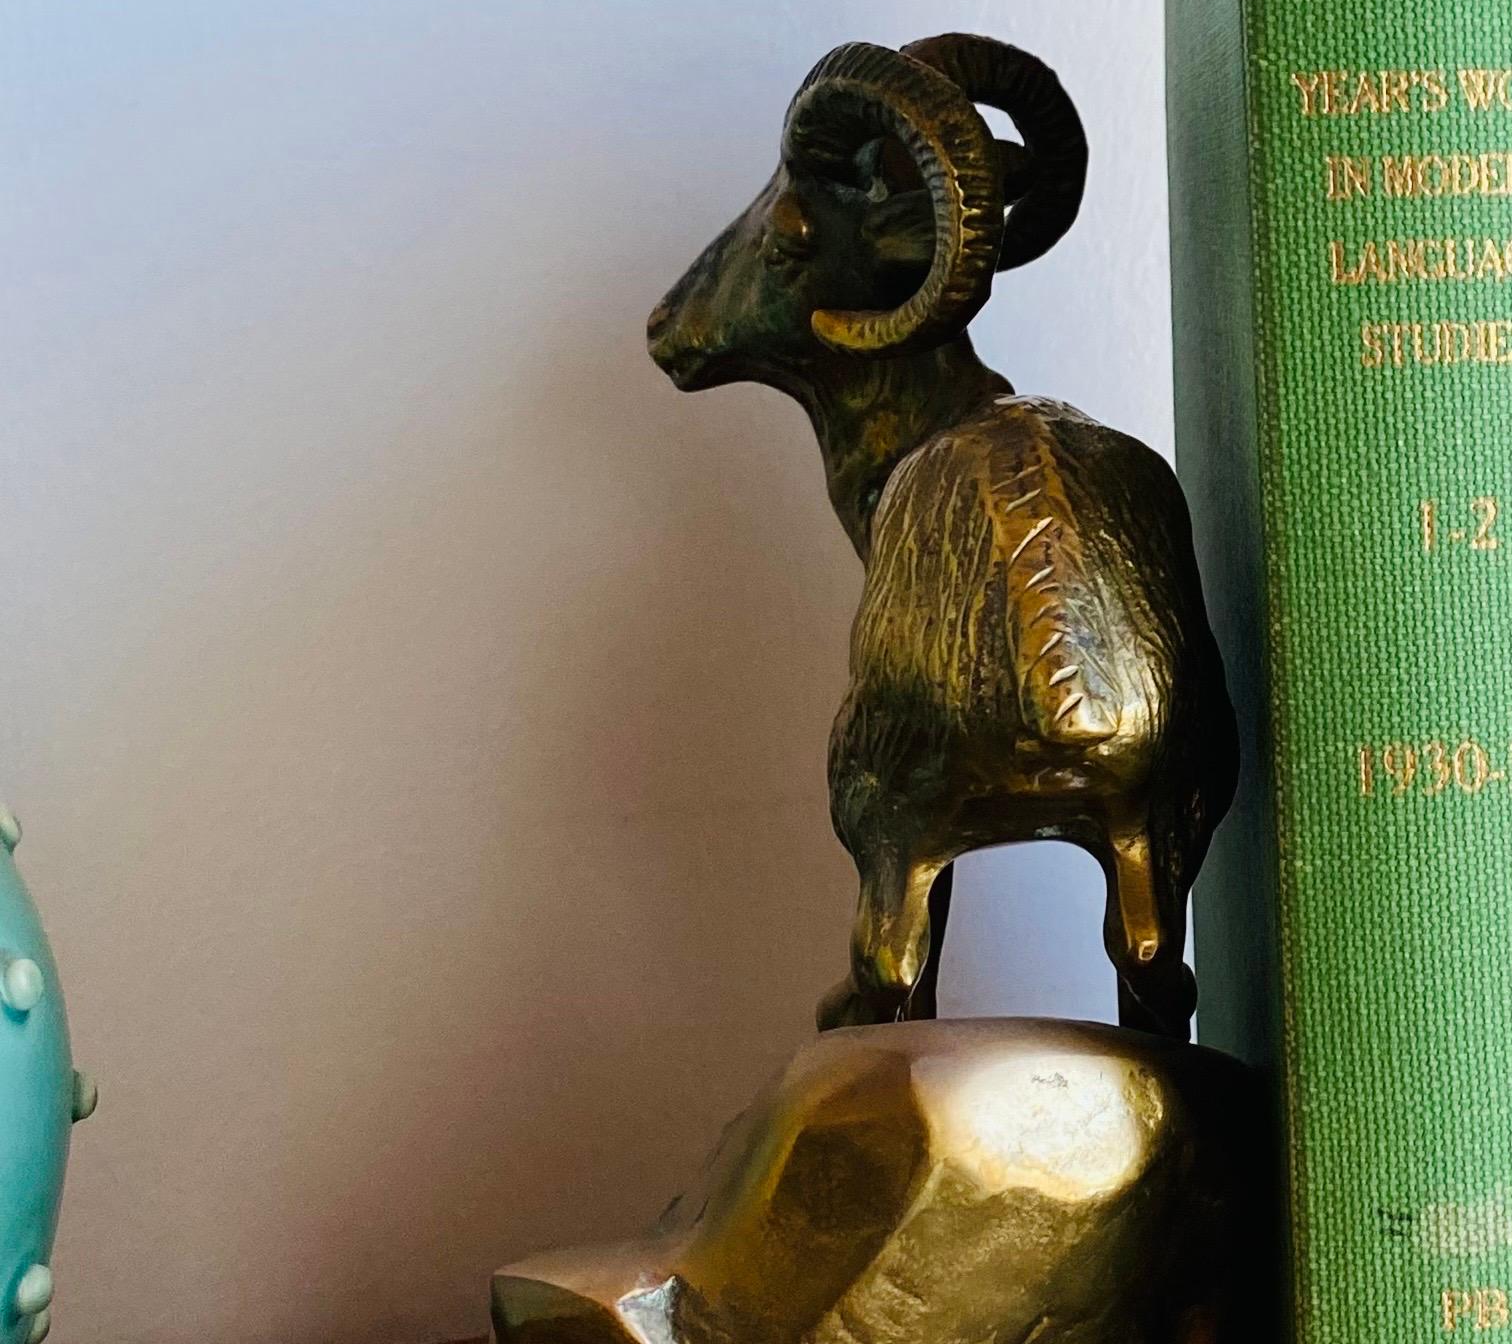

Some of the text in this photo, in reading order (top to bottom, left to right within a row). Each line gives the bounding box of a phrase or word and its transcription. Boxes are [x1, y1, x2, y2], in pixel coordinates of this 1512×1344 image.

[1291, 71, 1448, 115] YEAR'S
[1326, 156, 1377, 200] IN
[1419, 498, 1499, 550] 1-2
[1441, 1288, 1510, 1332] PB
